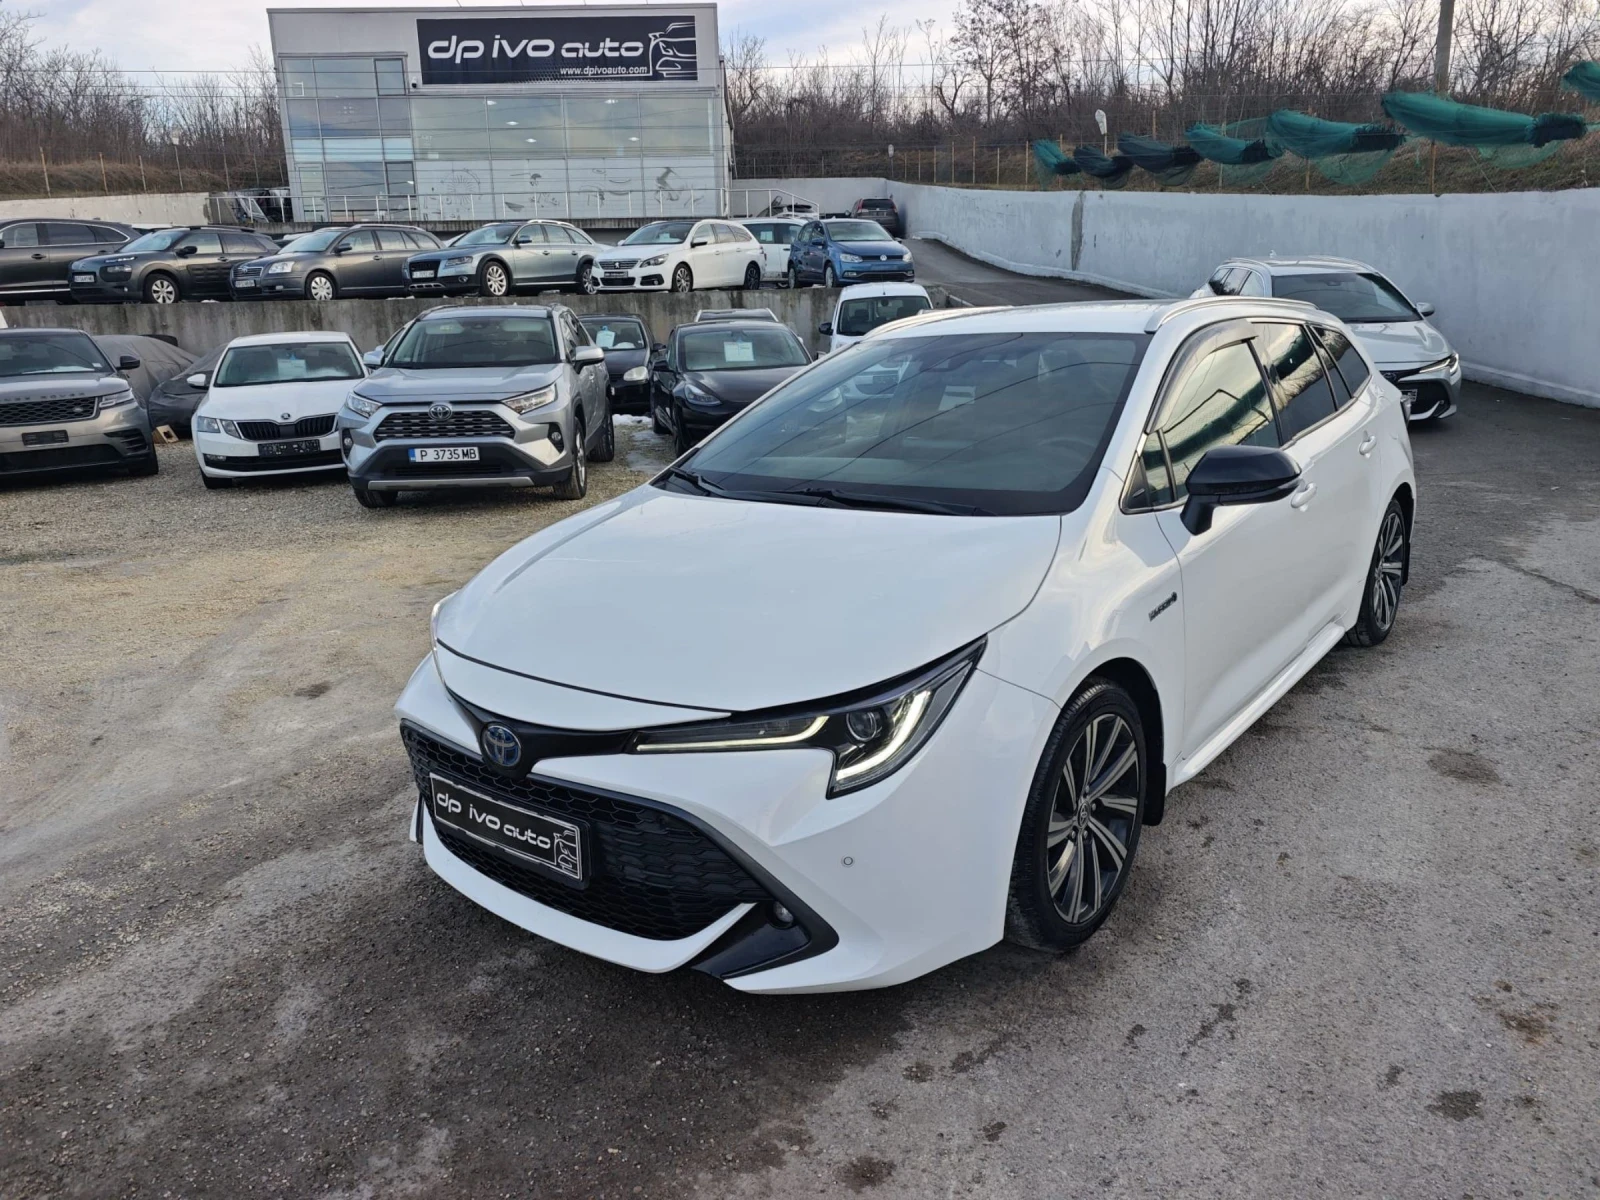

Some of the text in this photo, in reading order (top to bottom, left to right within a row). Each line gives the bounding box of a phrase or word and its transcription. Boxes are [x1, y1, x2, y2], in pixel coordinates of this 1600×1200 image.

[428, 34, 644, 63] dp ivo auto
[560, 65, 648, 75] www.dpivoauto.com
[420, 449, 428, 461] P
[436, 792, 551, 849] dp ivo auto
